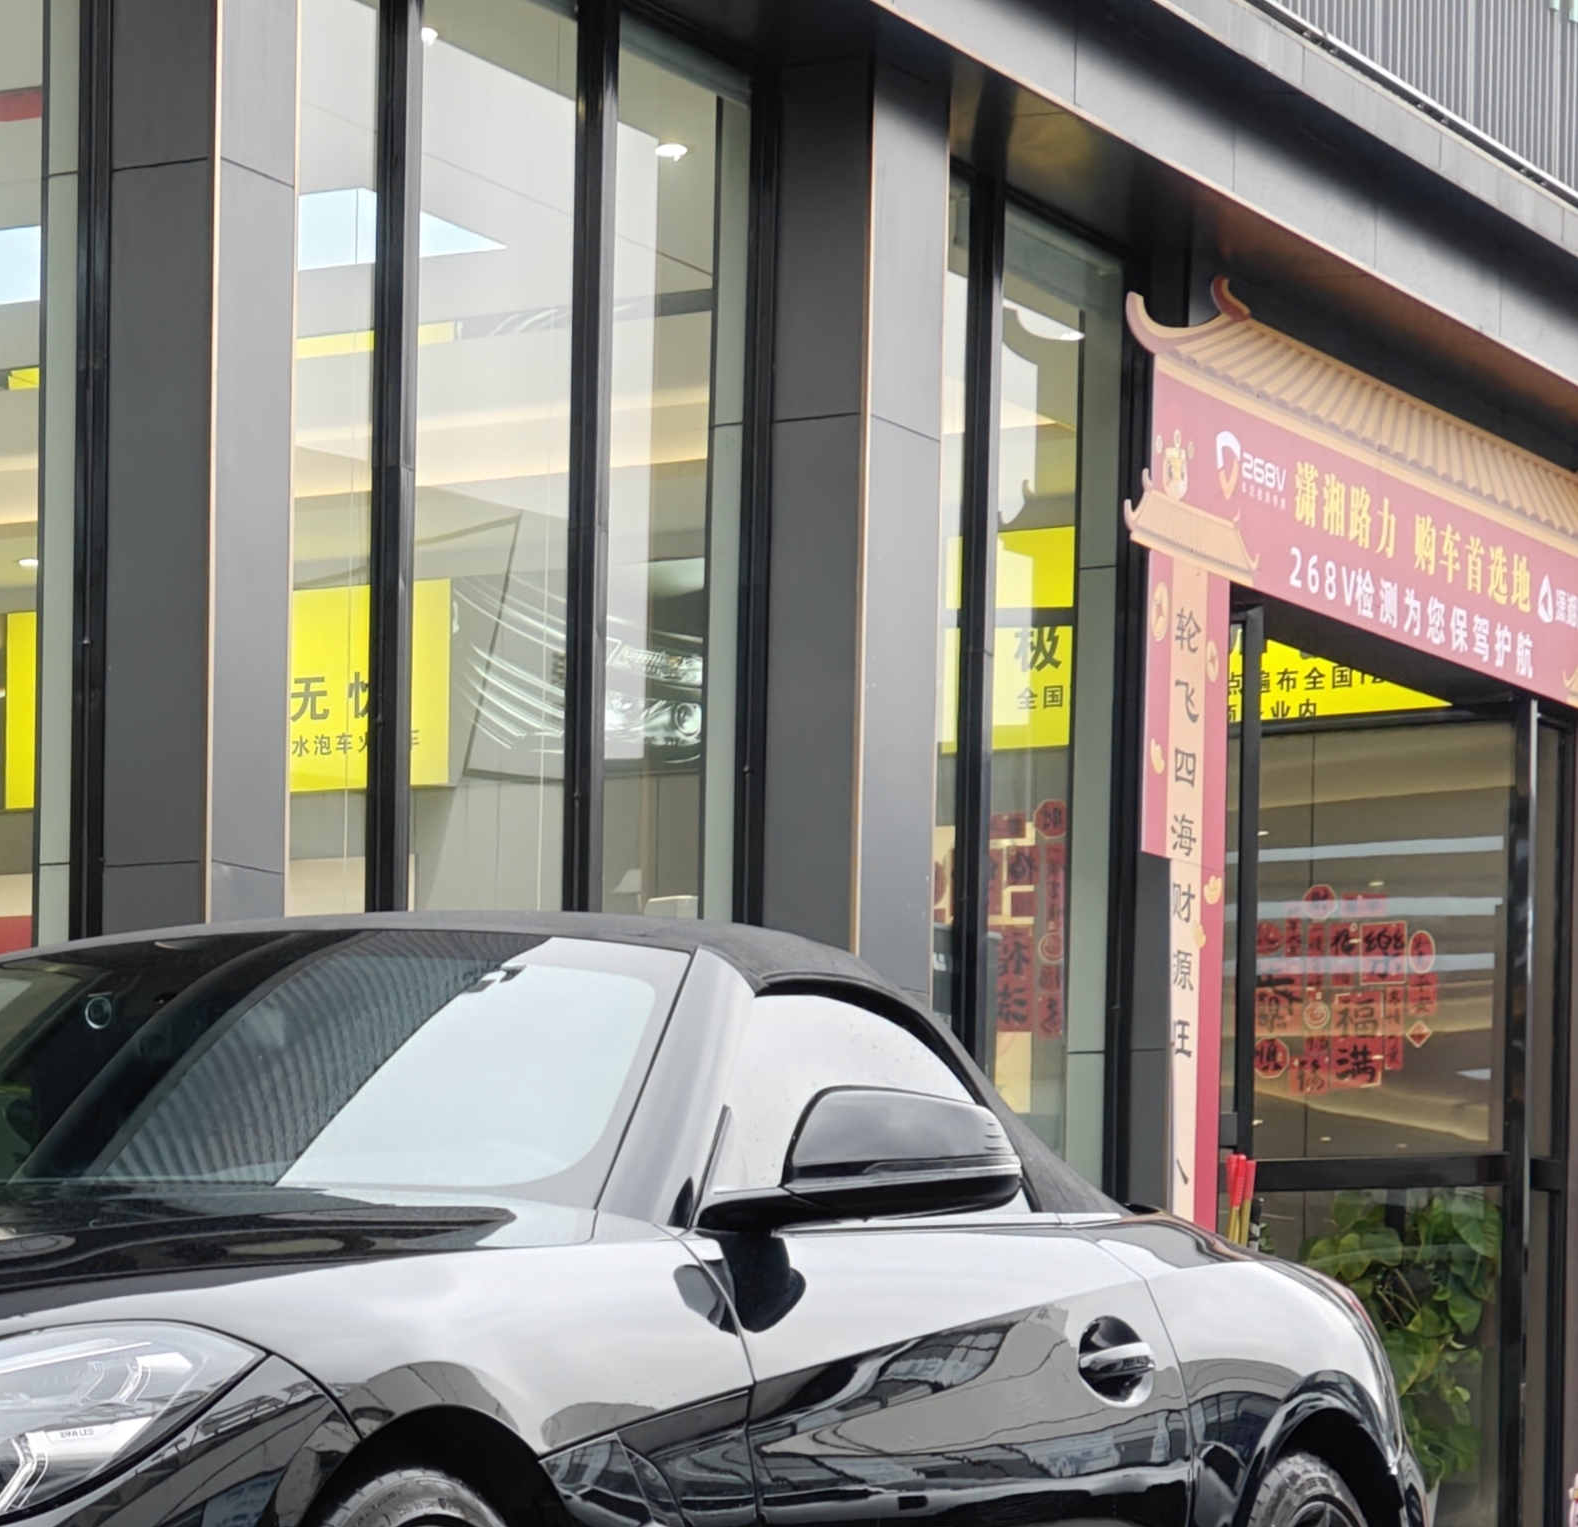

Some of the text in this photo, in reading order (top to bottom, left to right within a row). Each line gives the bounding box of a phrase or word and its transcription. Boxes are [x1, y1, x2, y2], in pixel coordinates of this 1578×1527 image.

[1241, 452, 1287, 492] 268V
[1294, 460, 1532, 613] 潇湘路力 购车首选地
[1014, 626, 1062, 672] 极
